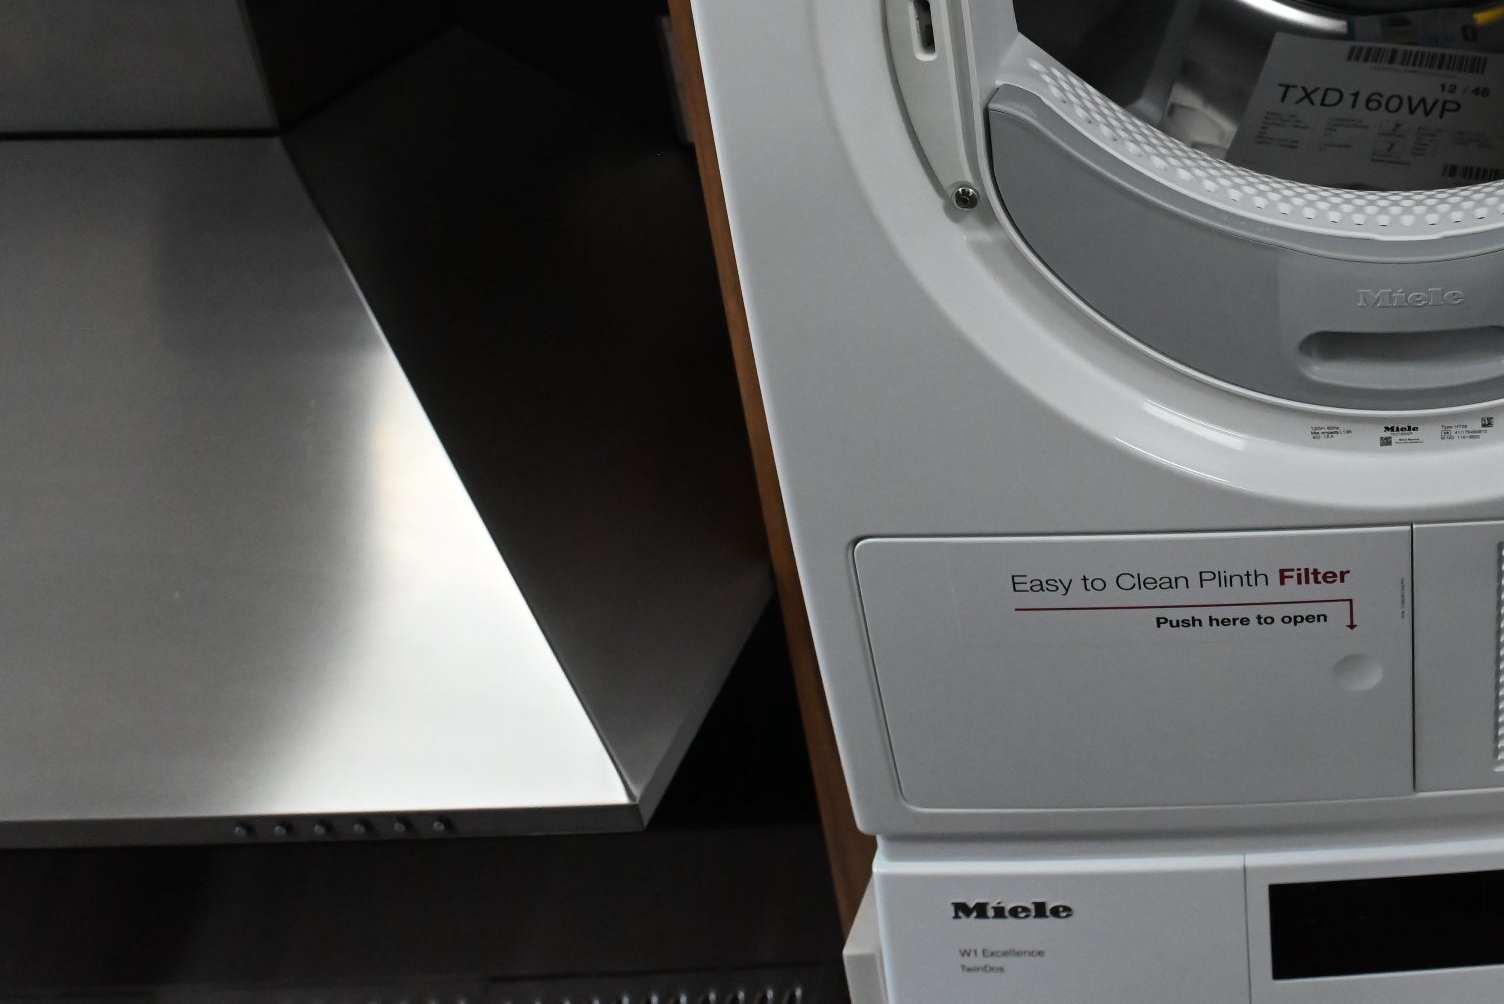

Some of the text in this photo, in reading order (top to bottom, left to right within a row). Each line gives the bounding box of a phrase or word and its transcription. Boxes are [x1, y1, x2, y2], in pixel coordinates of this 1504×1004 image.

[1440, 83, 1456, 94] 12
[1278, 83, 1462, 120] TXD160WP
[1357, 287, 1465, 308] Miele
[1383, 425, 1419, 433] Miele
[1010, 566, 1351, 596] Easy to Clean Plinth Filter
[1155, 612, 1328, 629] Push here to open
[951, 901, 1074, 920] Miele
